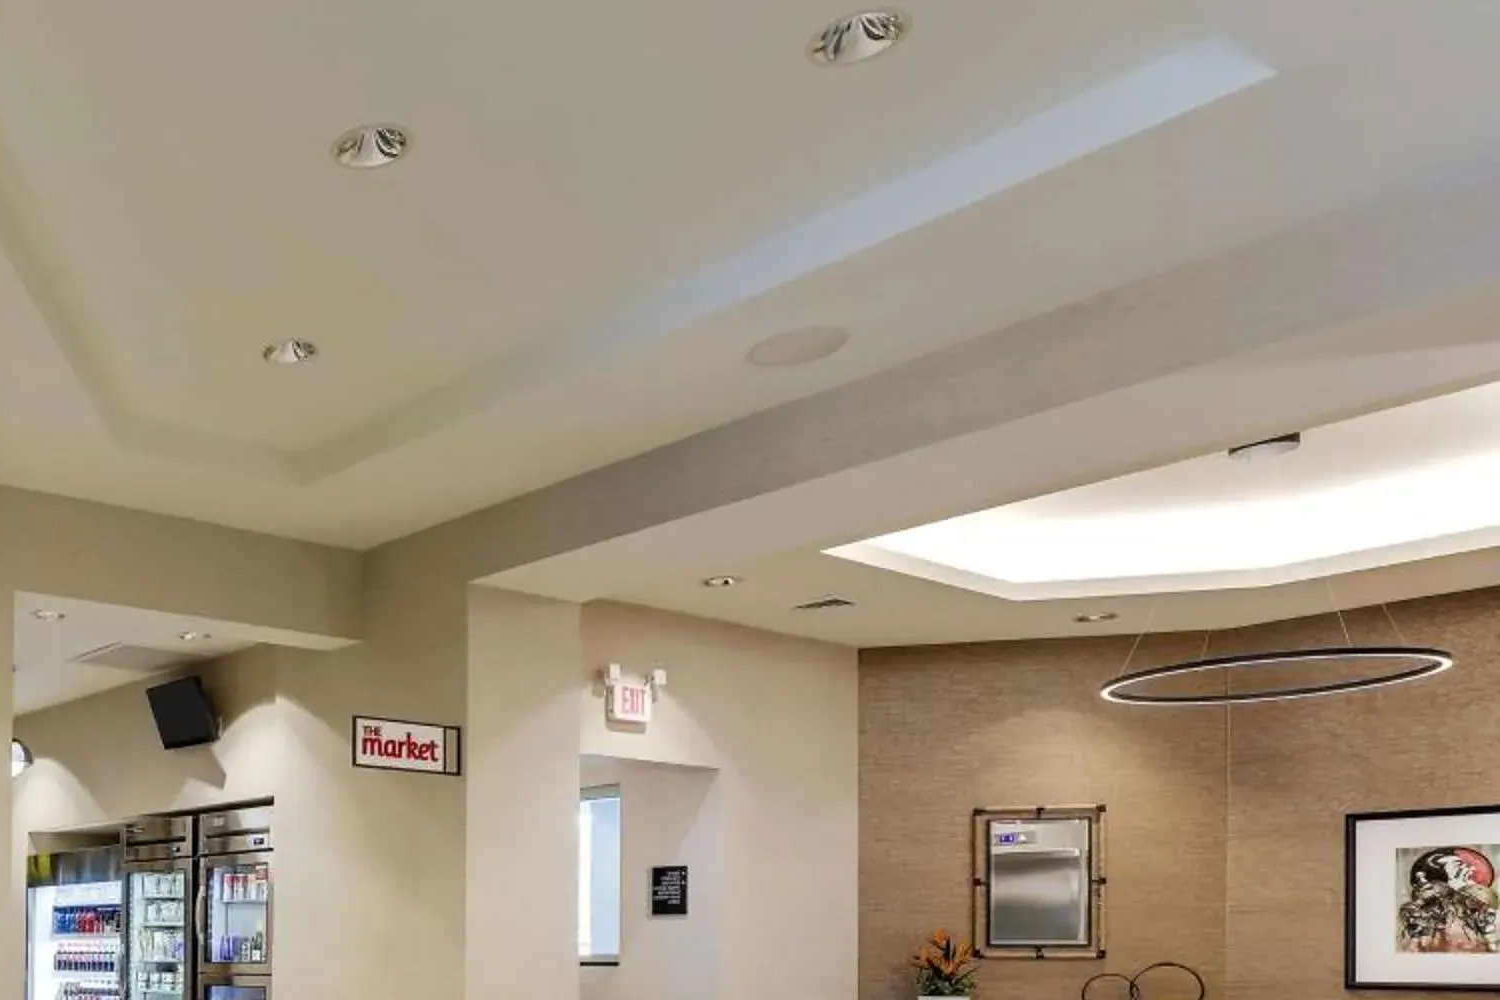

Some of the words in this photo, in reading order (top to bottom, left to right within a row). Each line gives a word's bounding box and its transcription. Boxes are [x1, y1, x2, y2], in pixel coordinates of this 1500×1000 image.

[622, 686, 647, 716] EXIT
[362, 725, 382, 737] THE
[362, 731, 439, 762] market
